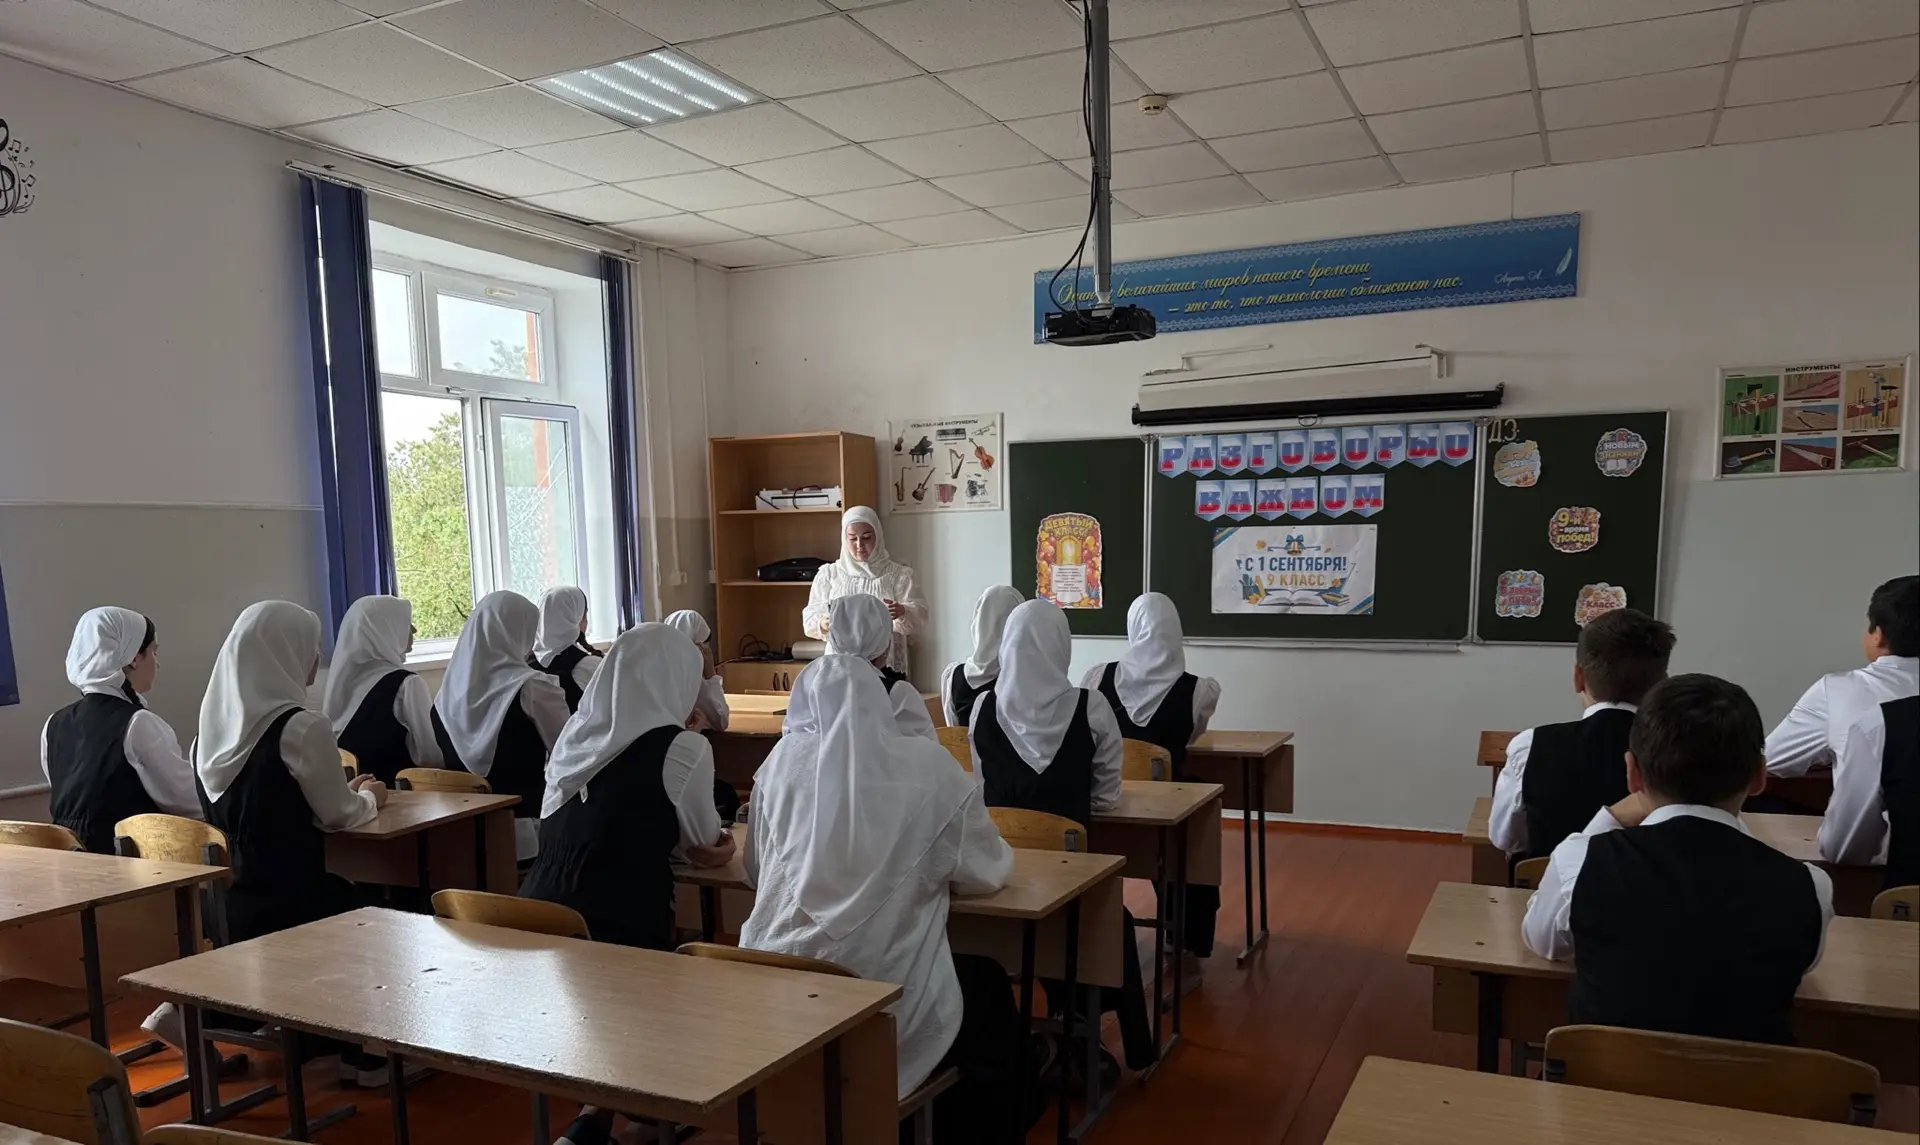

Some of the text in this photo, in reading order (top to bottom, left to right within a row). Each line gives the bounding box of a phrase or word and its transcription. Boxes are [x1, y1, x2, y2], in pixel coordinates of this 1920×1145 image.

[1117, 278, 1197, 298] величайших
[1201, 265, 1254, 296] мифов
[1252, 269, 1302, 284] нашего
[1308, 258, 1372, 287] времени
[1184, 301, 1210, 314] это
[1240, 295, 1263, 308] что
[1266, 286, 1347, 305] технологии
[1351, 277, 1431, 297] сближают
[1785, 364, 1841, 373] ИНСТРУМЕНТЫ
[1160, 428, 1440, 472] РАЗГОВОРЫ
[1197, 477, 1384, 515] ВАЖНОМ
[1245, 556, 1347, 572] С 1 СЕНТЯБРЯ!
[1267, 574, 1325, 586] 9 КЛАСС
